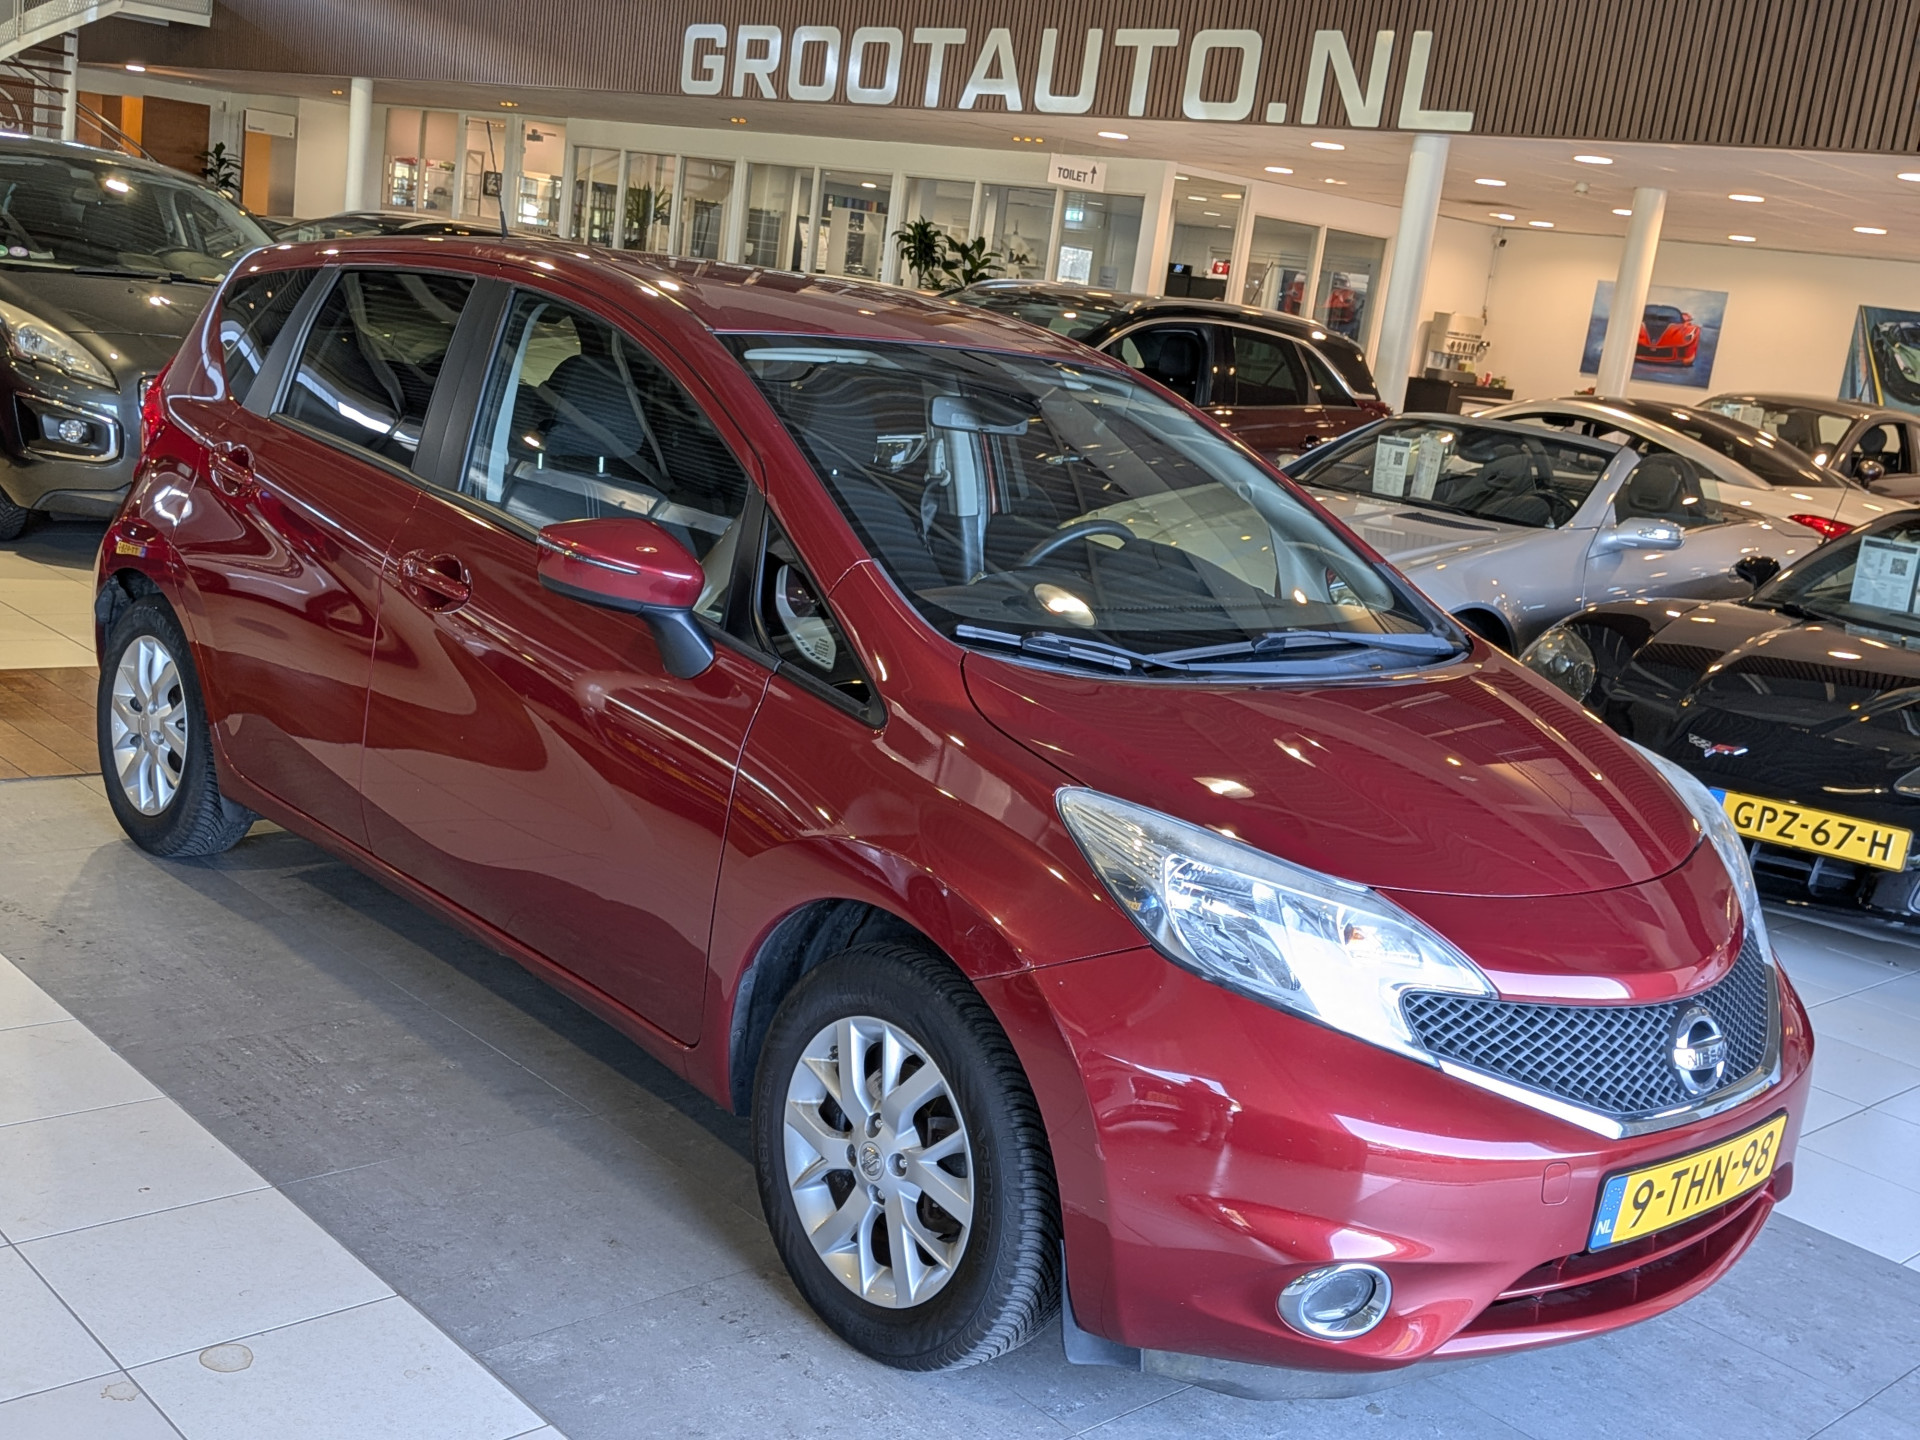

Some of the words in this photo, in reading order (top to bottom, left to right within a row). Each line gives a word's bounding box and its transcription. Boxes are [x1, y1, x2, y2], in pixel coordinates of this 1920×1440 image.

[681, 24, 1474, 131] GROOTAUTO.NL
[1057, 167, 1088, 183] TOILET
[1733, 801, 1893, 861] GPZ-67-H
[1629, 1131, 1774, 1229] 9-THN-98
[1596, 1219, 1612, 1236] NL
